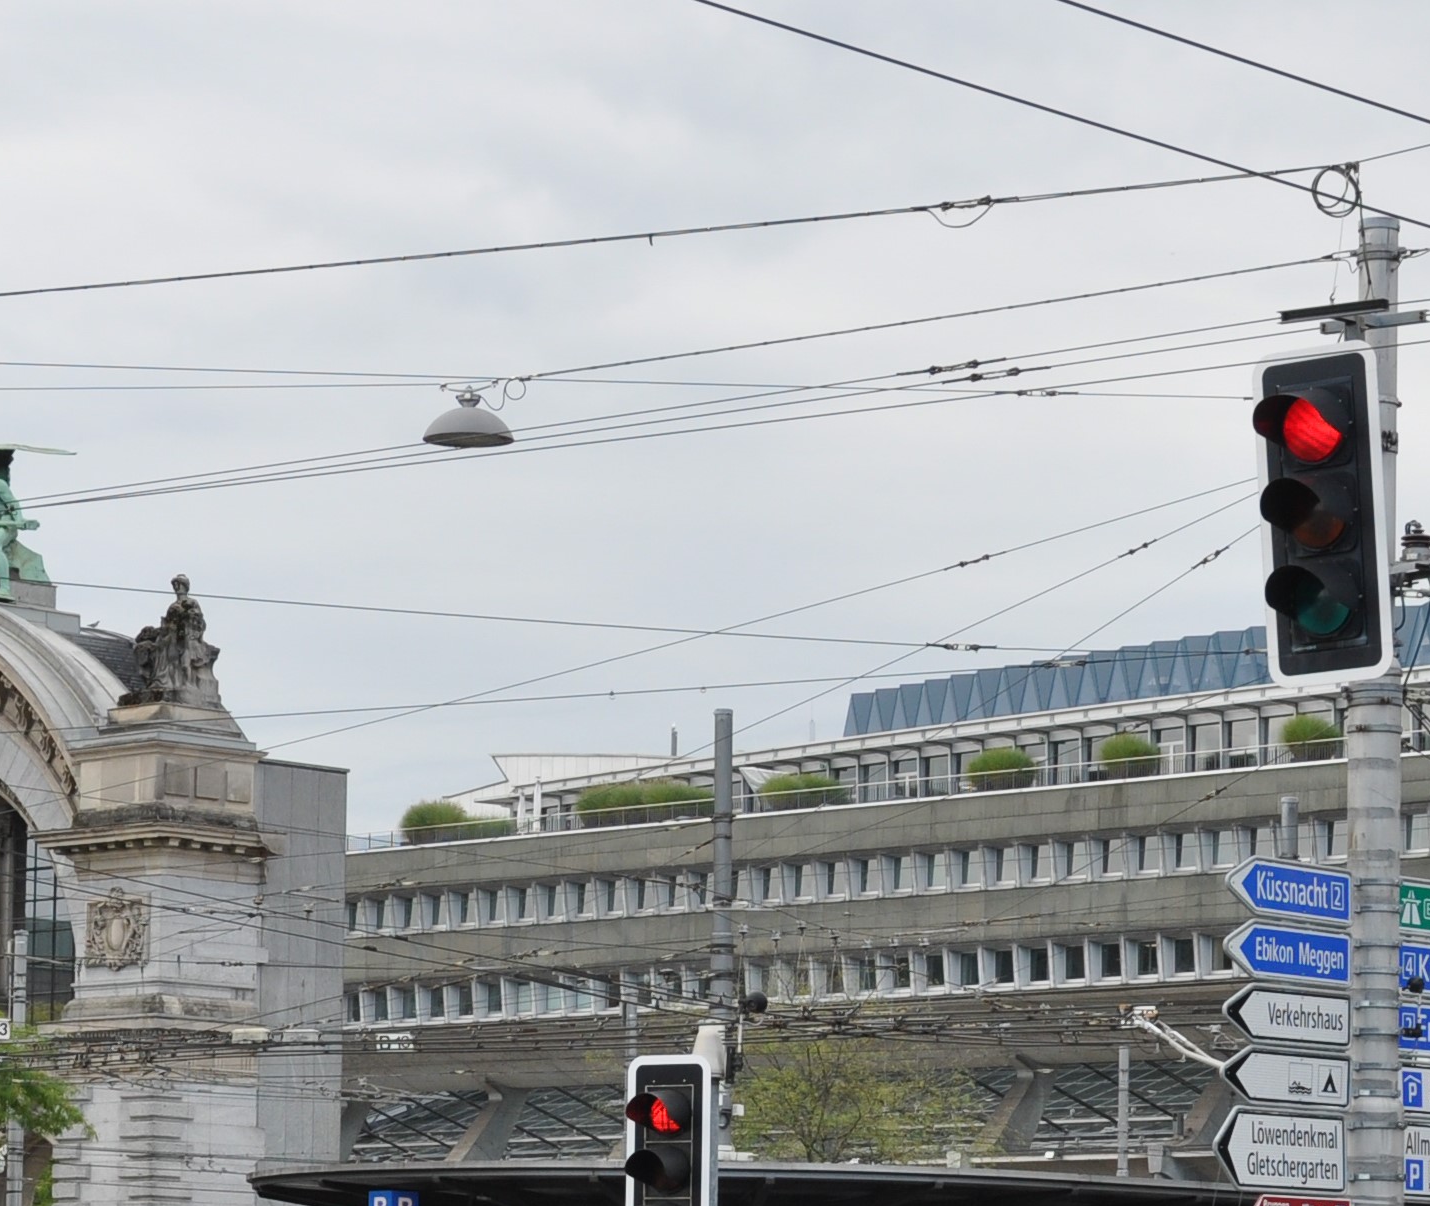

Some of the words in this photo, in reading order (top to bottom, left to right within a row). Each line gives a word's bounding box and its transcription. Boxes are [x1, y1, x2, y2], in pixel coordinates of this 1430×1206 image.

[1256, 870, 1328, 909] Küssnacht
[1334, 886, 1341, 906] 2
[1255, 936, 1293, 964] Ebikon
[1298, 942, 1344, 974] Meggen
[1405, 957, 1414, 976] 4
[1267, 1002, 1344, 1031] Verkehrshaus
[1251, 1120, 1338, 1149] Löwendenkmal
[1247, 1152, 1338, 1185] Gletschergarten
